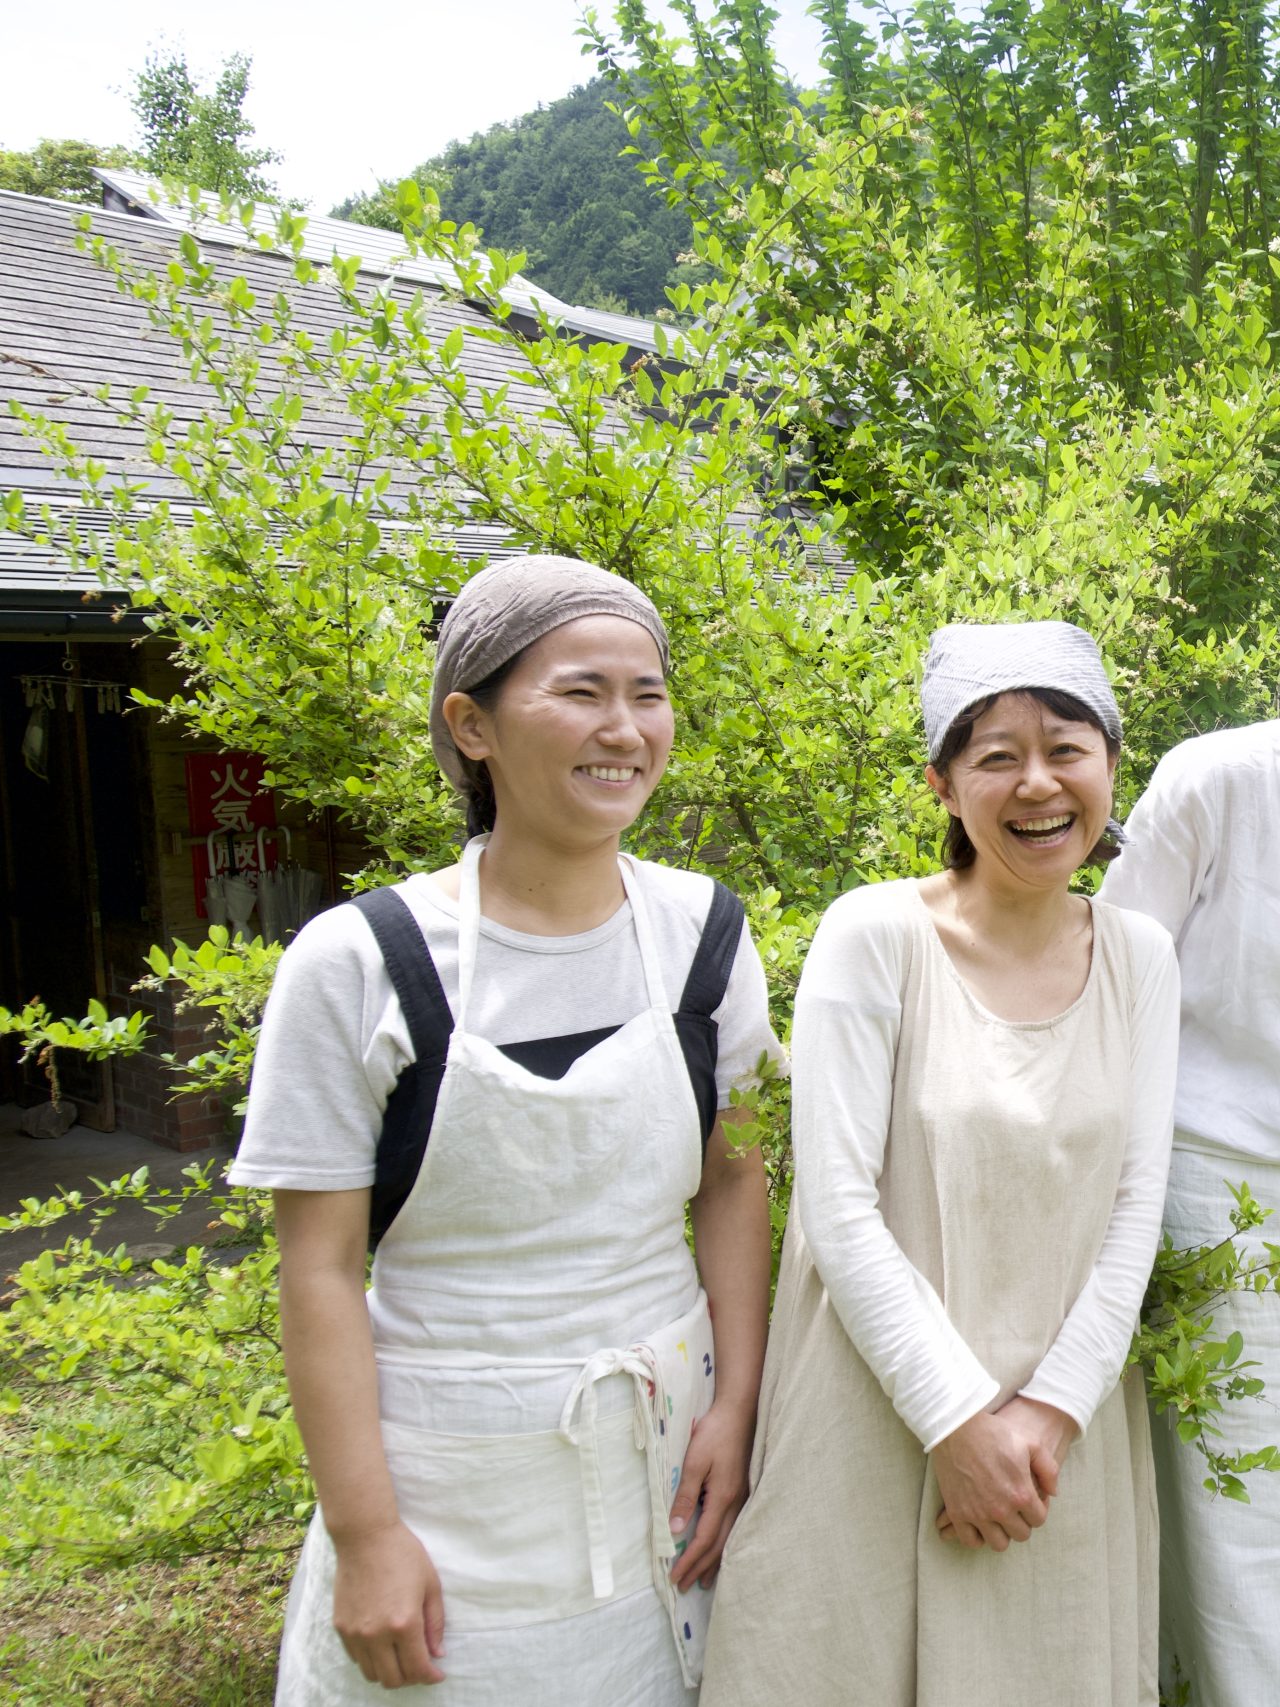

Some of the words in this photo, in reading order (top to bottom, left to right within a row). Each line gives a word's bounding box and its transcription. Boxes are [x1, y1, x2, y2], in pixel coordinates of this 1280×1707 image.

[210, 763, 258, 890] 火気厳
[702, 1352, 713, 1377] 2
